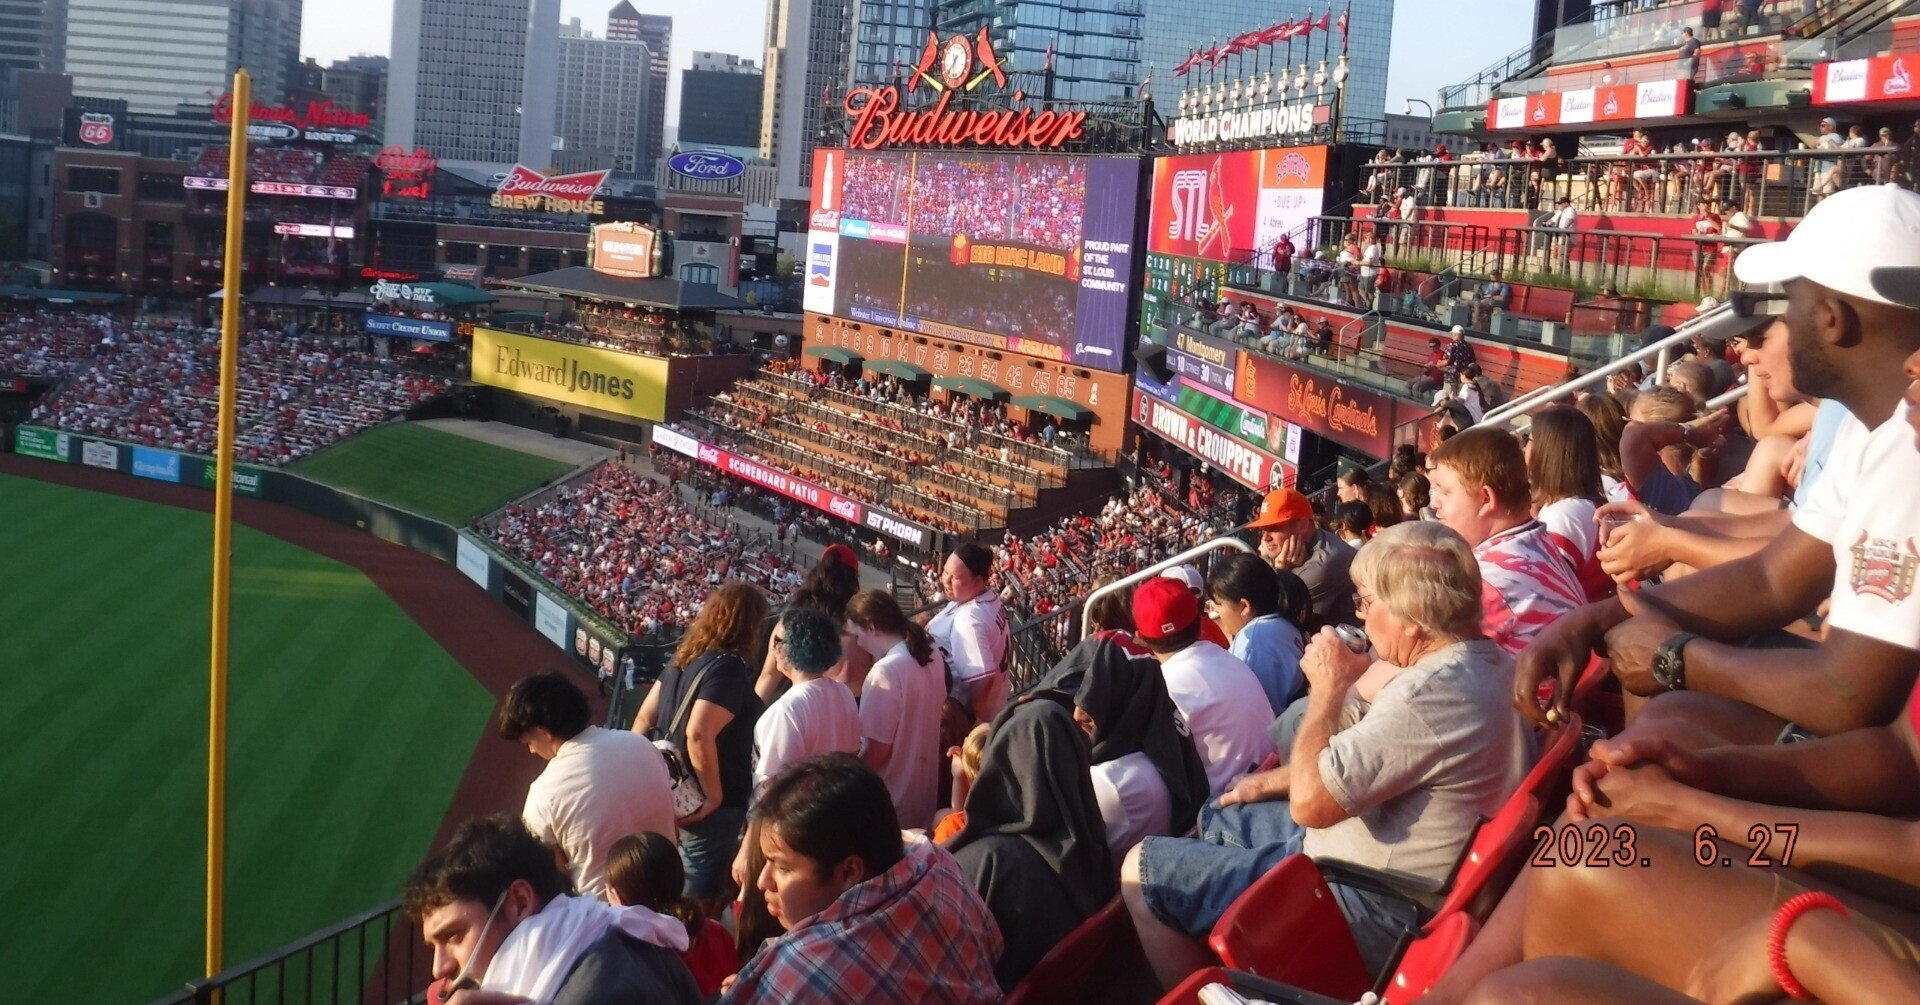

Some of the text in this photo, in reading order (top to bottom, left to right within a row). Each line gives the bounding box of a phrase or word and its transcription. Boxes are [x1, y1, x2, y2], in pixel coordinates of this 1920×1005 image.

[844, 86, 1086, 150] Budweiser
[1175, 103, 1314, 146] WORLD CHAMPIONS
[85, 125, 107, 139] 66
[684, 155, 729, 175] Ford
[493, 173, 603, 195] Budweiser
[490, 194, 605, 215] BREW HOUSE
[970, 245, 1066, 276] BIG MAC LAND
[1083, 253, 1109, 265] OF THE
[1085, 240, 1130, 254] PROUD PART
[1081, 278, 1126, 292] COMMUNITY
[1094, 266, 1115, 279] LOUIS
[391, 322, 421, 333] CREDIT
[421, 325, 449, 337] UNION
[833, 327, 1075, 400] 1 2 6 9 10 14 17 20 23 24 42 45 85
[1176, 333, 1226, 368] 47 Montgomery
[496, 344, 634, 400] Edward Jones
[1177, 355, 1185, 372] 10
[1200, 363, 1210, 383] 30
[1224, 372, 1234, 392] 40
[1328, 386, 1378, 436] Cardinals
[1152, 402, 1188, 444] BROWN
[1188, 427, 1195, 449] &
[1198, 426, 1263, 486] CROUPPEN
[729, 457, 818, 503] SCOREBOARD PATIO
[829, 495, 856, 519] Coca-Cola
